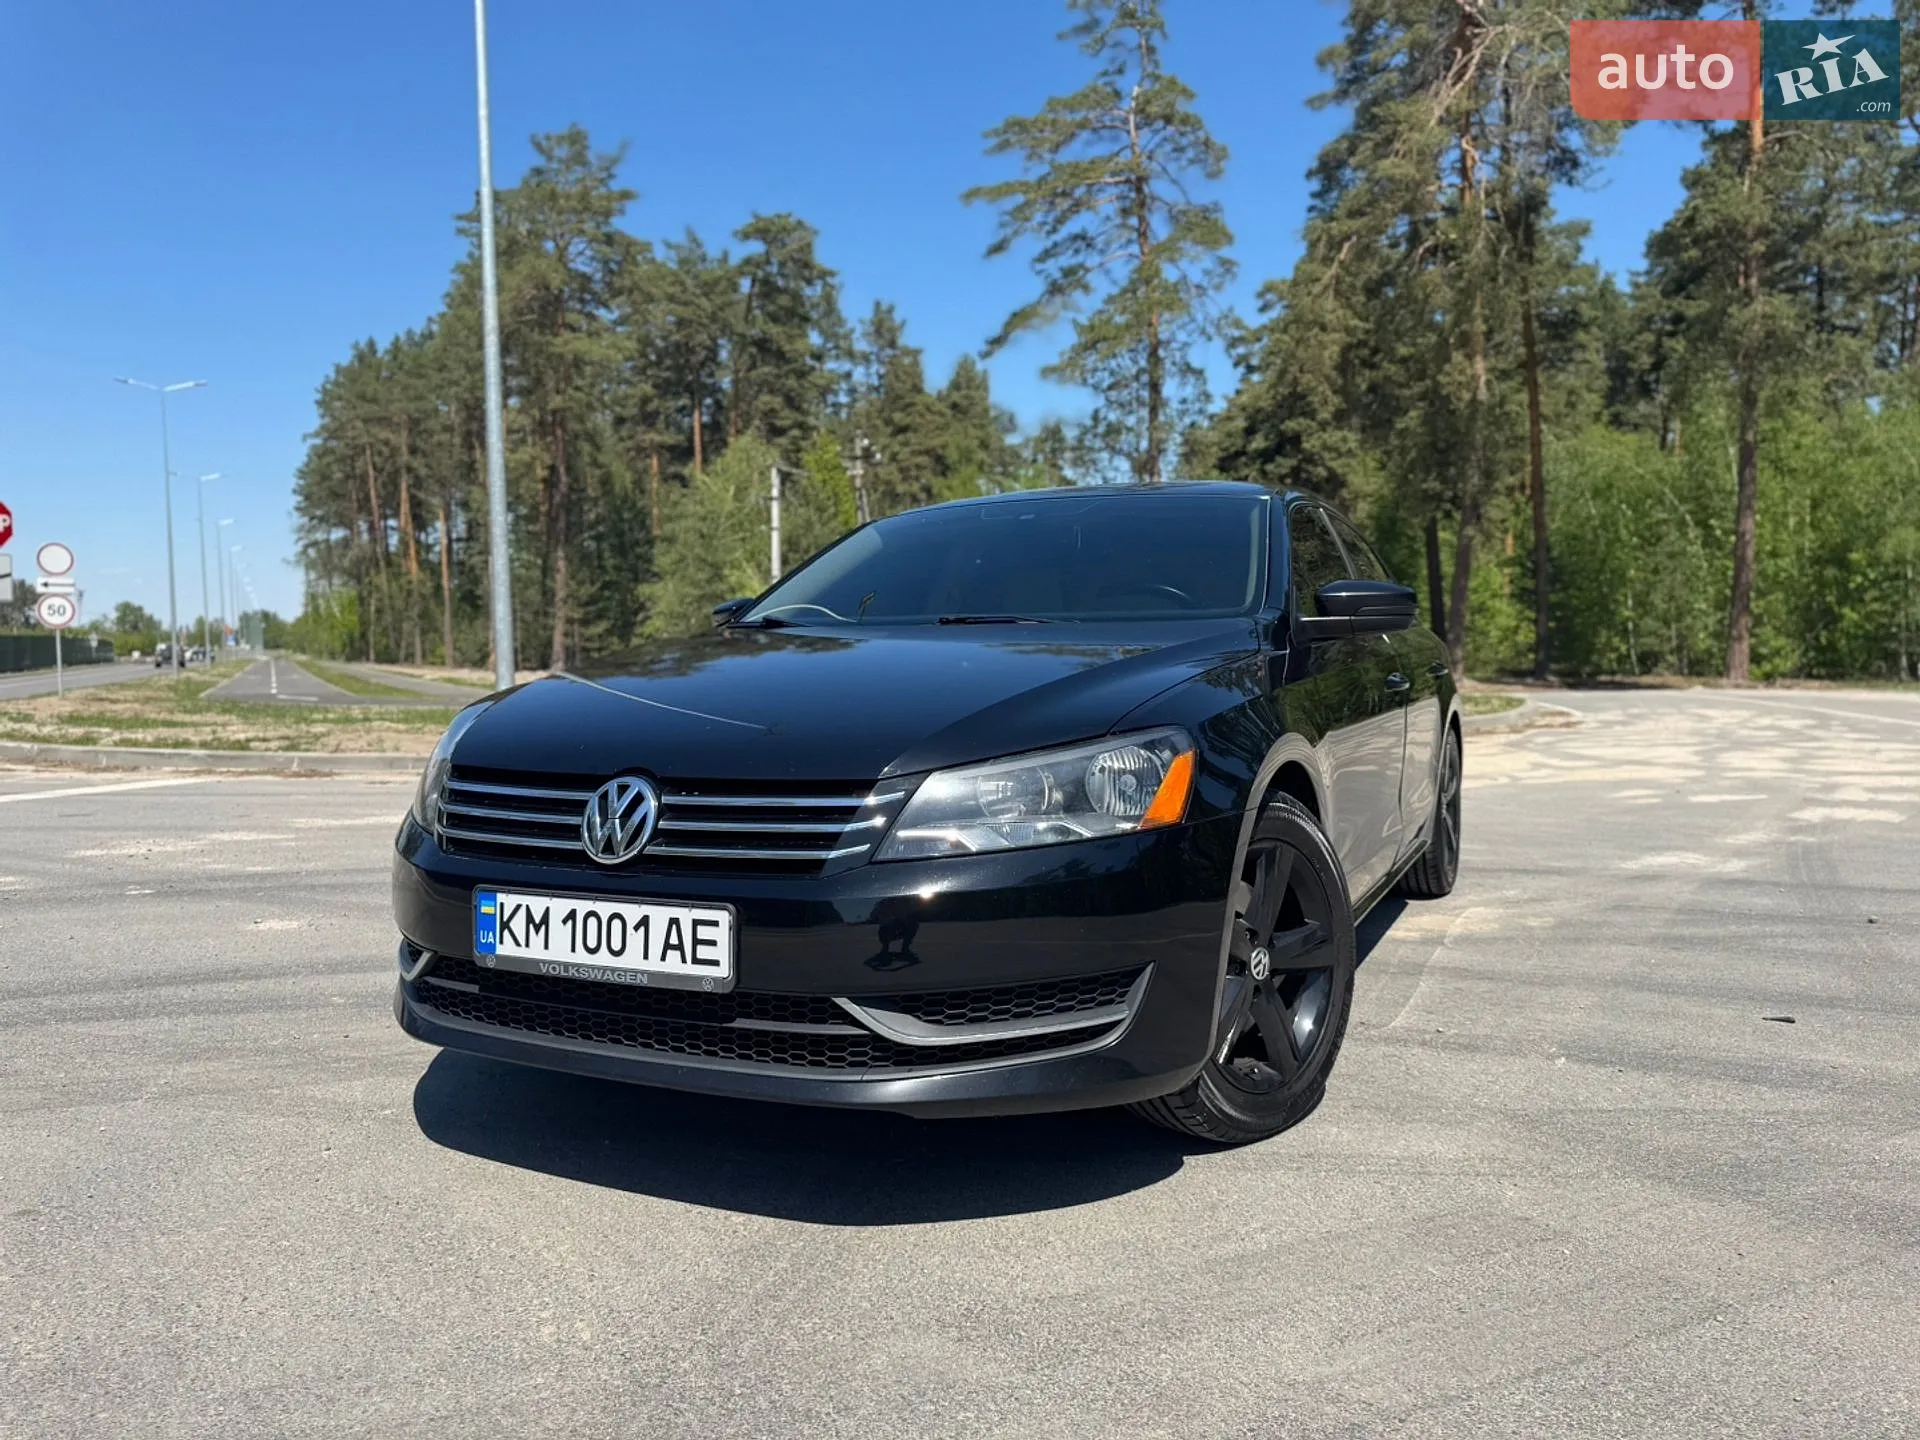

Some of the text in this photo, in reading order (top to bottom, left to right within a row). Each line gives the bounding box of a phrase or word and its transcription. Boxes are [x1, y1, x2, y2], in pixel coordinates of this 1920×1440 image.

[47, 604, 66, 617] 50
[479, 930, 495, 944] UA
[499, 902, 721, 967] KM 1001 AE
[538, 962, 649, 985] VOLKSWAGEN
